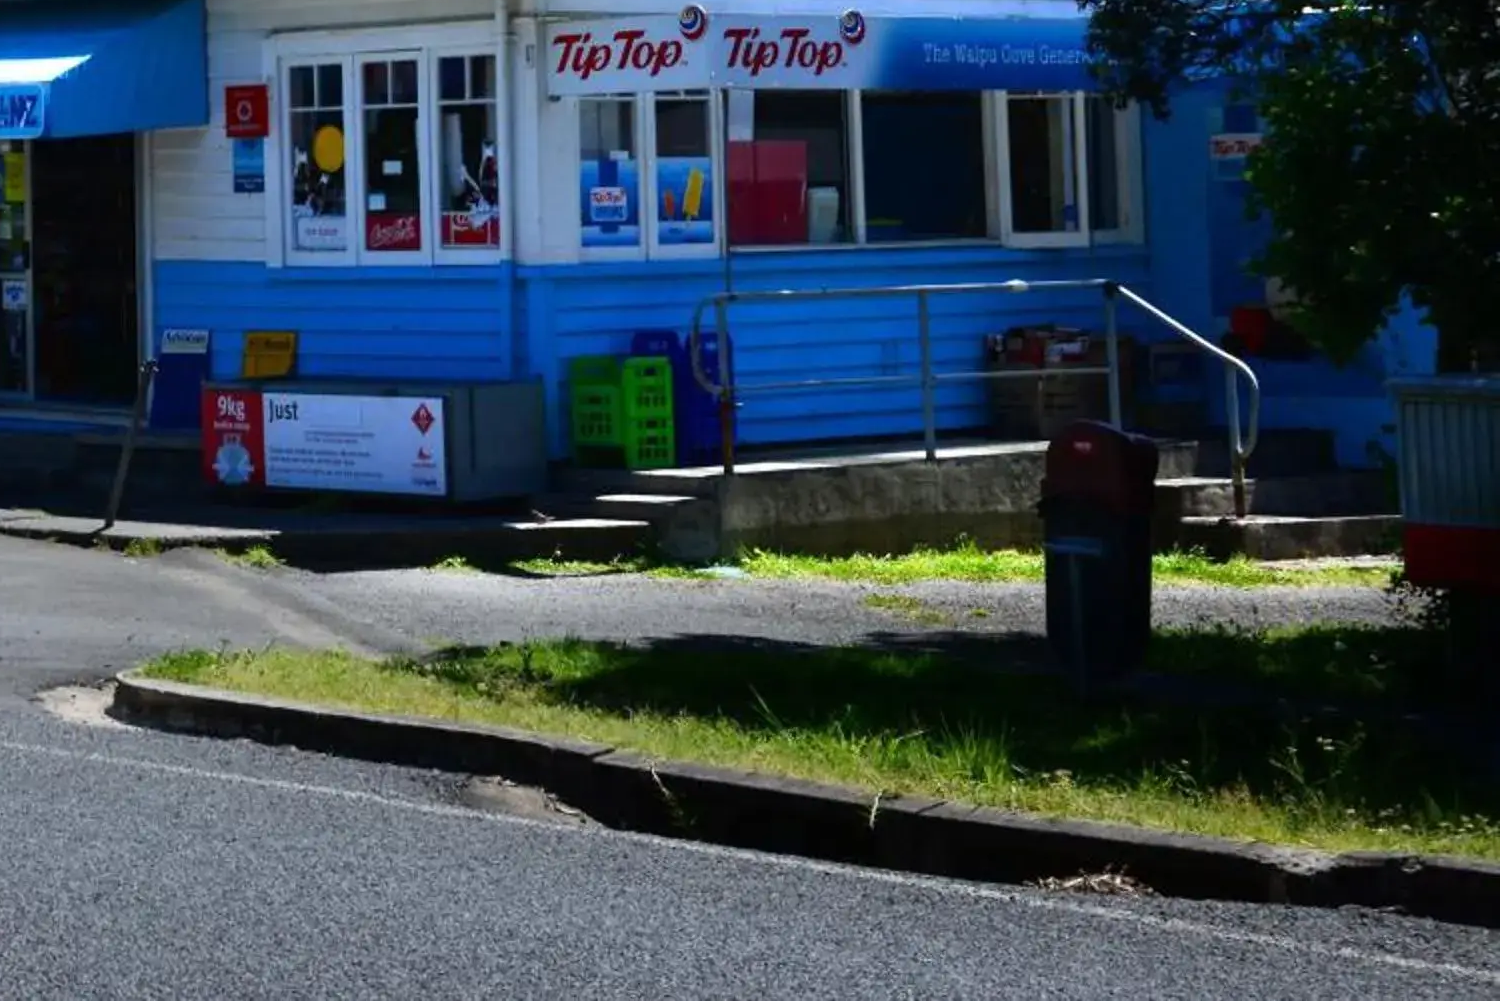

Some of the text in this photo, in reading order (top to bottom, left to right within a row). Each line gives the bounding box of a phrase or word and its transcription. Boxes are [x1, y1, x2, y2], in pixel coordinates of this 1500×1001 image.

[553, 29, 684, 81] Tip Top
[723, 27, 844, 77] Tip Top
[922, 42, 950, 64] The
[216, 394, 246, 422] 9kg
[267, 398, 299, 424] Just
